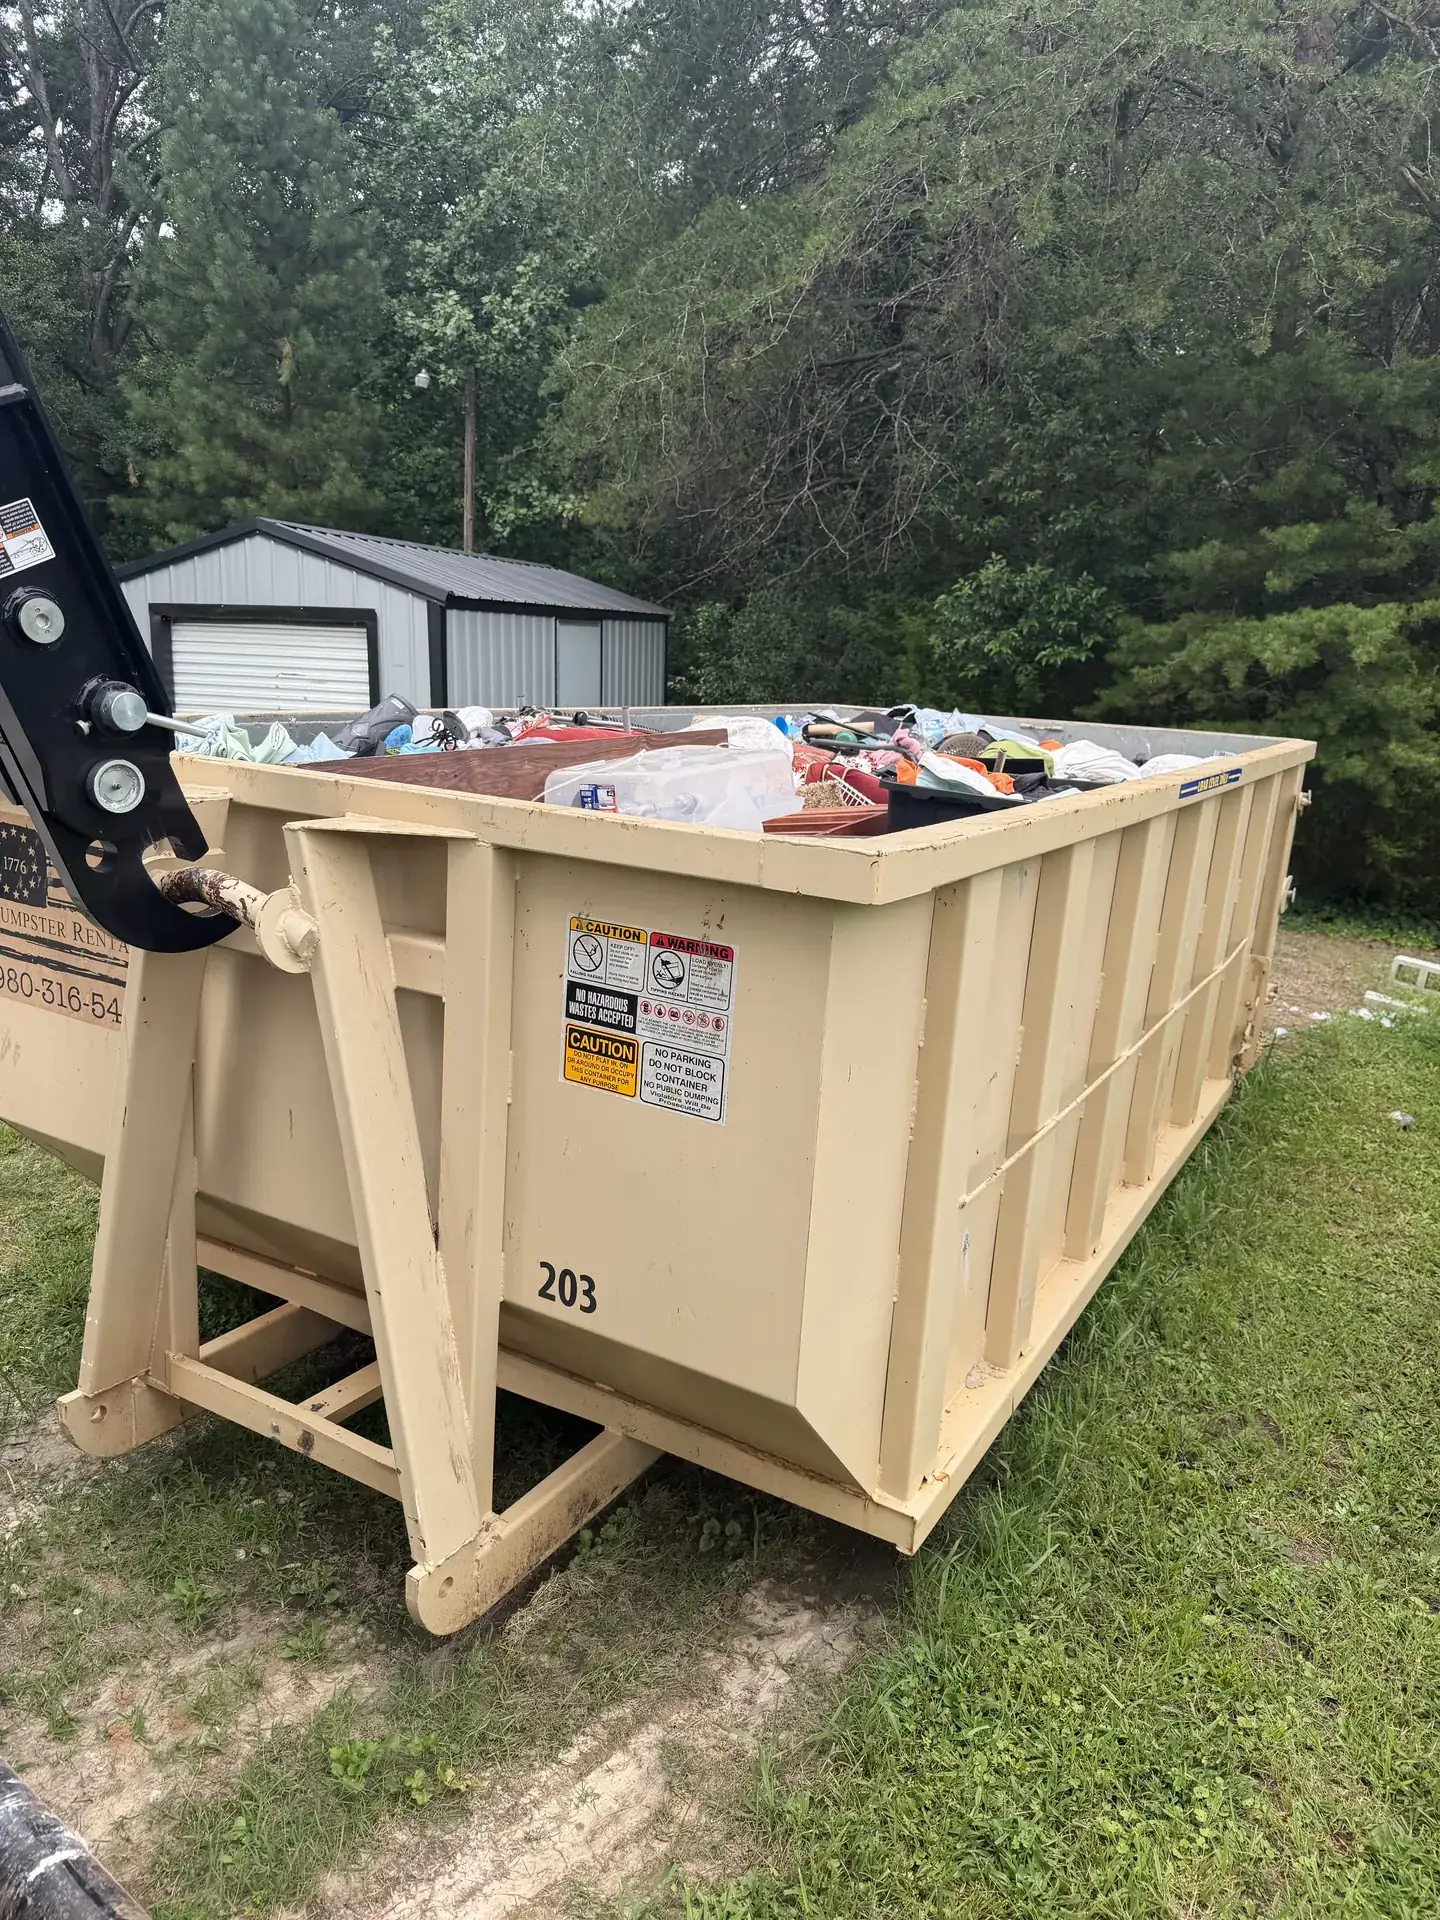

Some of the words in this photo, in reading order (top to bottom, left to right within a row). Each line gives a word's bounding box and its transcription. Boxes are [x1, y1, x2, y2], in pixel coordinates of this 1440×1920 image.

[3, 856, 28, 875] 1776
[0, 907, 66, 938] UMPSTER
[72, 921, 129, 954] RENTA
[586, 922, 641, 941] CAUTION
[667, 938, 729, 959] WARNING
[576, 988, 586, 1001] NO
[587, 990, 628, 1012] HAZARDOUS
[569, 1000, 597, 1019] WASTES
[598, 1009, 634, 1028] ACCEPTED
[570, 1032, 633, 1061] CAUTION
[582, 1052, 594, 1060] NOT
[596, 1055, 610, 1064] PLAY
[655, 1048, 668, 1059] NO
[671, 1051, 711, 1069] PARKING
[571, 1066, 583, 1074] THIS
[584, 1068, 616, 1082] CONTAINER
[617, 1078, 629, 1086] FOR
[576, 1059, 600, 1070] AROUND
[601, 1064, 609, 1072] OR
[611, 1067, 635, 1078] OCCUPY
[649, 1059, 661, 1069] DO
[663, 1062, 683, 1074] NOT
[685, 1068, 717, 1082] BLOCK
[580, 1076, 591, 1084] ANY
[593, 1079, 619, 1091] PURPOSE
[655, 1072, 708, 1092] CONTAINER
[644, 1080, 655, 1089] NO
[656, 1084, 683, 1096] PUBLIC
[684, 1089, 719, 1105] DUMPING
[650, 1090, 682, 1103] Violators
[685, 1099, 699, 1107] Will
[658, 1098, 701, 1114] Prosecuted
[538, 1261, 597, 1314] 203
